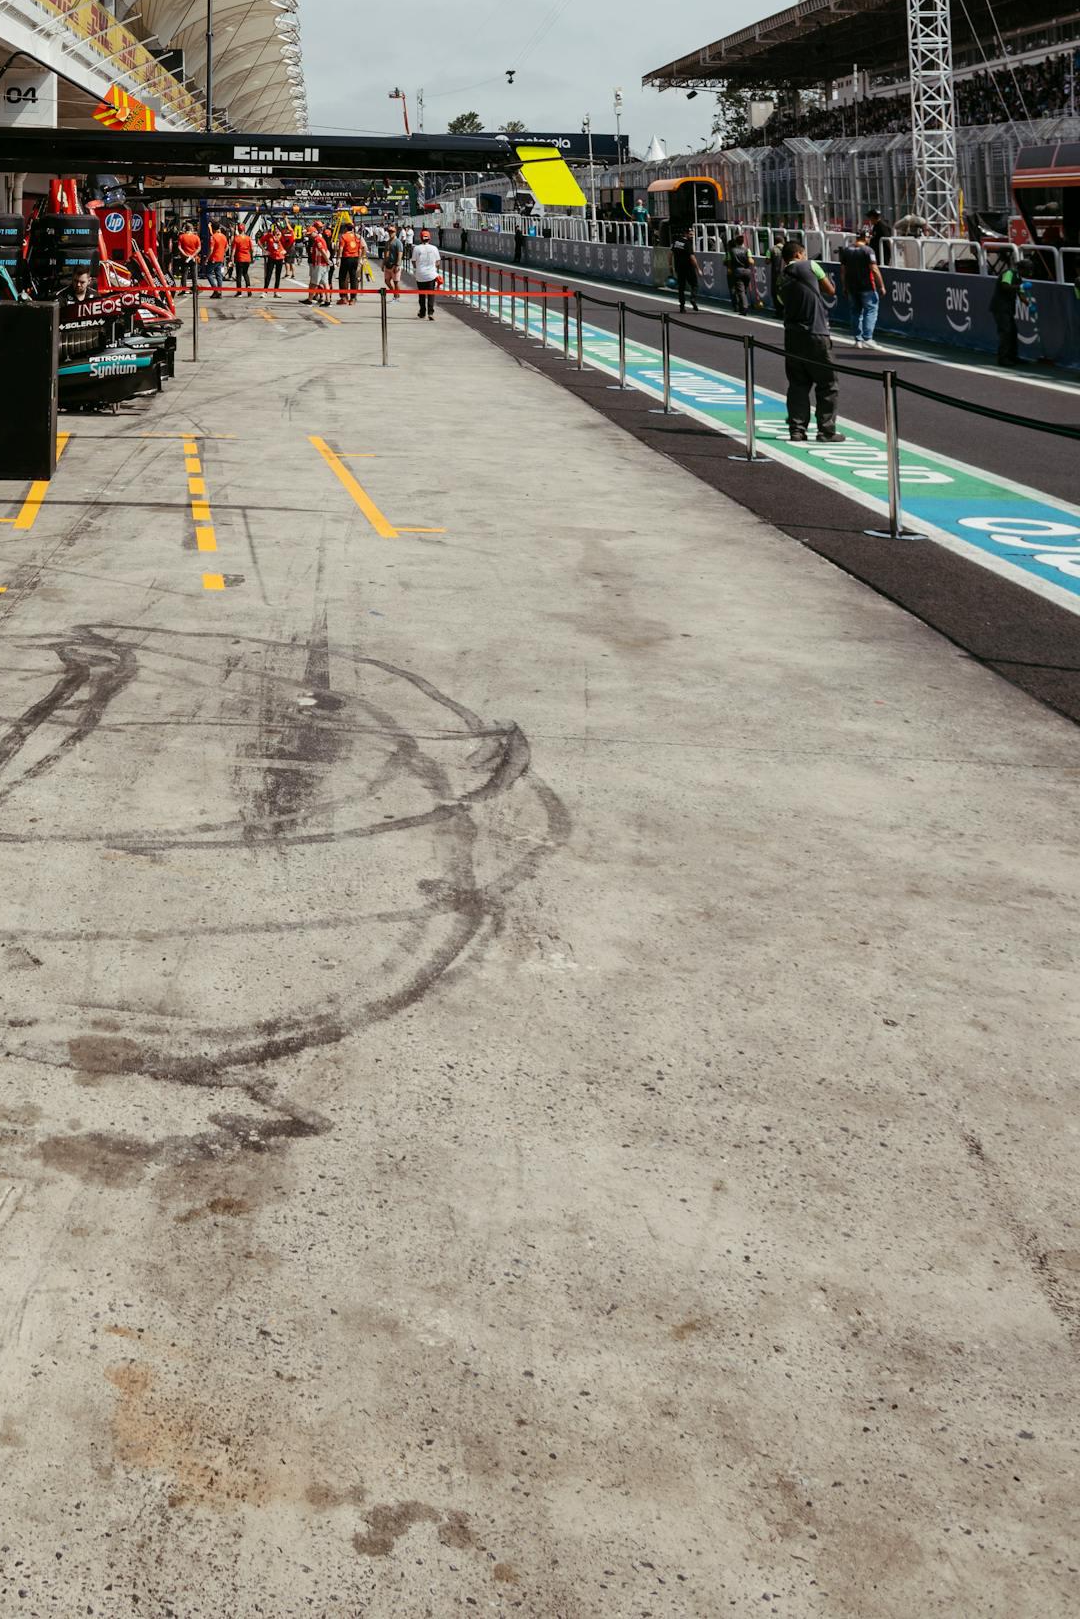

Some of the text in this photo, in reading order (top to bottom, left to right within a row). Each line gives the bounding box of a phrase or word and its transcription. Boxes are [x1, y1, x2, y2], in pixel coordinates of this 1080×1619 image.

[6, 86, 39, 104] 04
[233, 146, 319, 162] Einhell
[209, 164, 273, 174] Einhell
[108, 213, 123, 232] hp
[892, 281, 912, 305] aws
[946, 287, 969, 312] aws
[77, 297, 122, 318] INEOS
[65, 320, 98, 329] SOLERA
[89, 354, 137, 363] PETRONAS
[89, 363, 137, 378] Syntium
